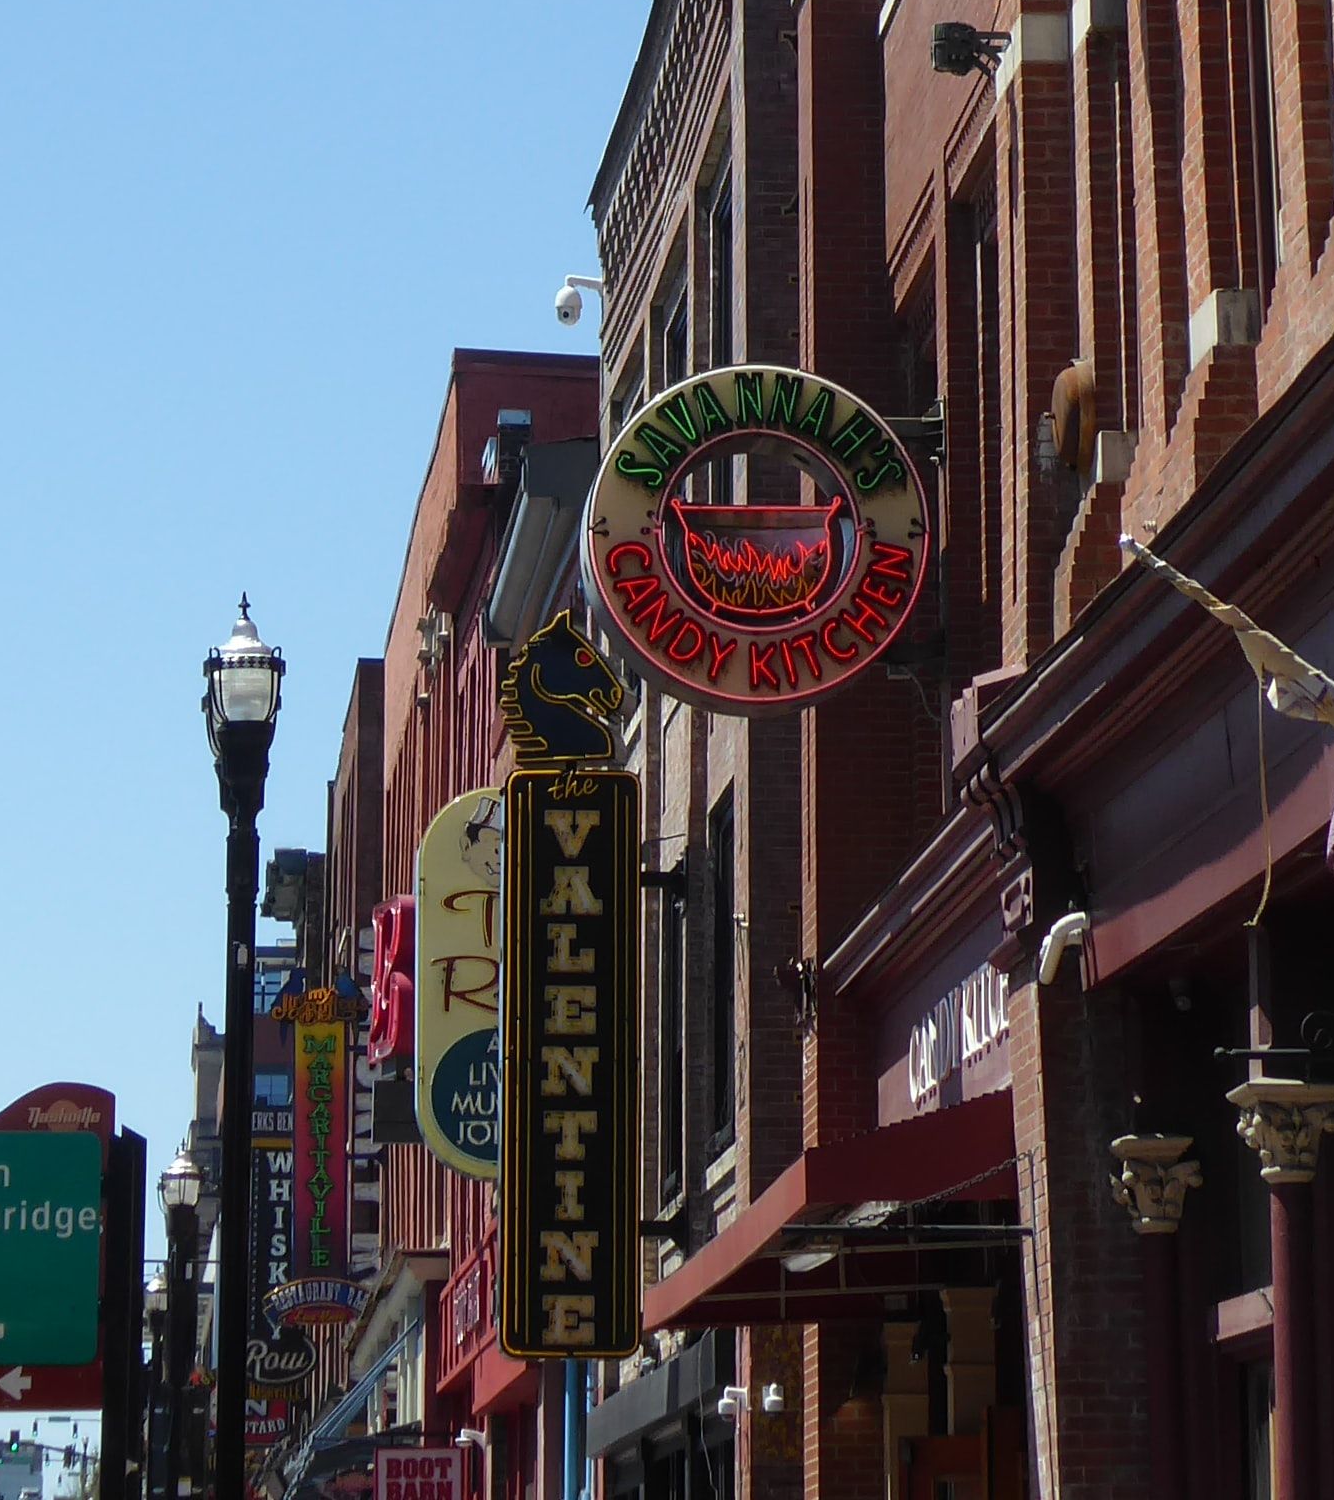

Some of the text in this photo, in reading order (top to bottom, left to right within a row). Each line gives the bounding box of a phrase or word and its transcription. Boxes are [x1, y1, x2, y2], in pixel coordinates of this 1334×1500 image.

[616, 372, 907, 493] SAVANNAH'S
[606, 541, 915, 692] CANDY KITCHEN
[547, 775, 600, 801] the
[468, 1060, 499, 1086] LIV
[539, 809, 604, 1346] VALENTINE
[450, 1090, 499, 1116] MU
[27, 1106, 101, 1129] Nashville
[455, 1121, 499, 1146] JOI
[303, 1035, 336, 1268] MARGARITAVILLE
[386, 1457, 453, 1480] BOOT
[386, 1481, 454, 1500] BARN
